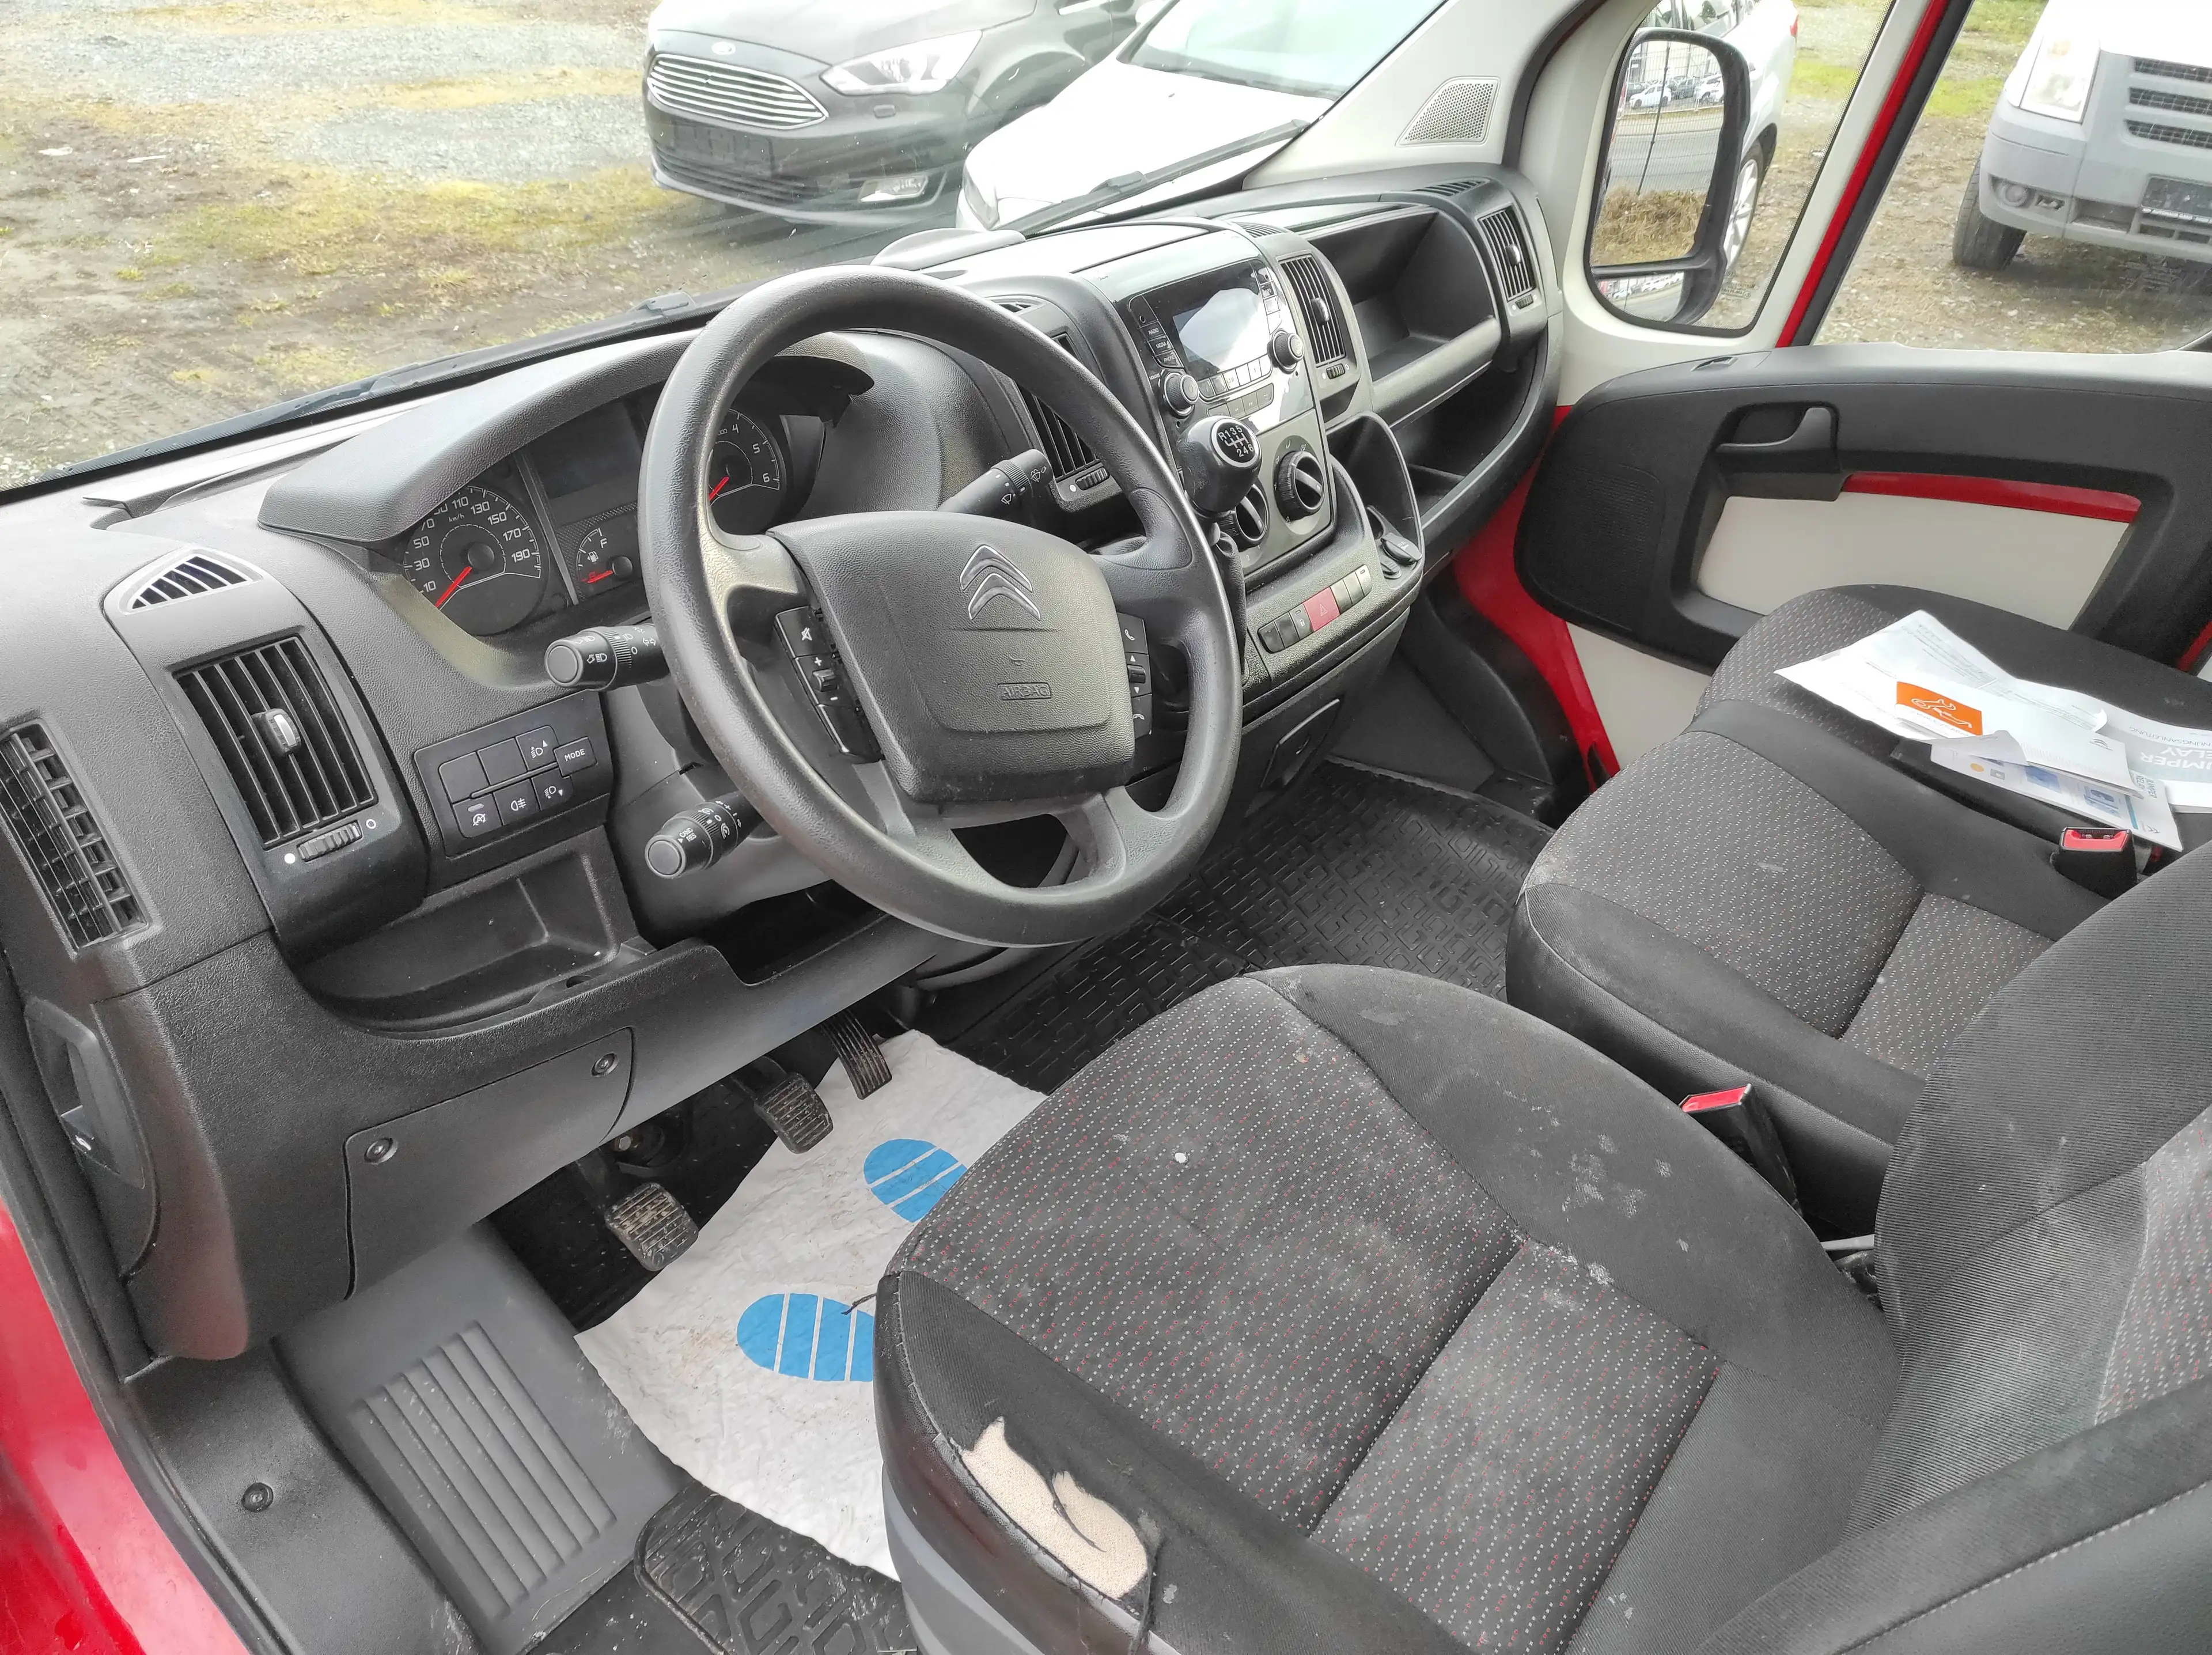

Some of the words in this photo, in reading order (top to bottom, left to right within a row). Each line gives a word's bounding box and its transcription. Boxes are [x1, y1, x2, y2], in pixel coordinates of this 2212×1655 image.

[732, 423, 739, 434] 4
[752, 444, 760, 453] 5
[763, 473, 770, 483] 6
[452, 497, 468, 509] 110
[471, 501, 490, 514] 130
[448, 514, 465, 522] km/h
[488, 512, 507, 525] 150
[503, 528, 521, 541] 170
[413, 536, 430, 549] 50
[600, 537, 607, 548] F
[512, 548, 530, 563] 190
[414, 558, 430, 571] 30
[423, 580, 437, 592] 10
[1001, 686, 1051, 697] AIRBAG
[565, 749, 585, 762] MODE
[679, 828, 694, 838] CANC
[686, 833, 697, 842] RES
